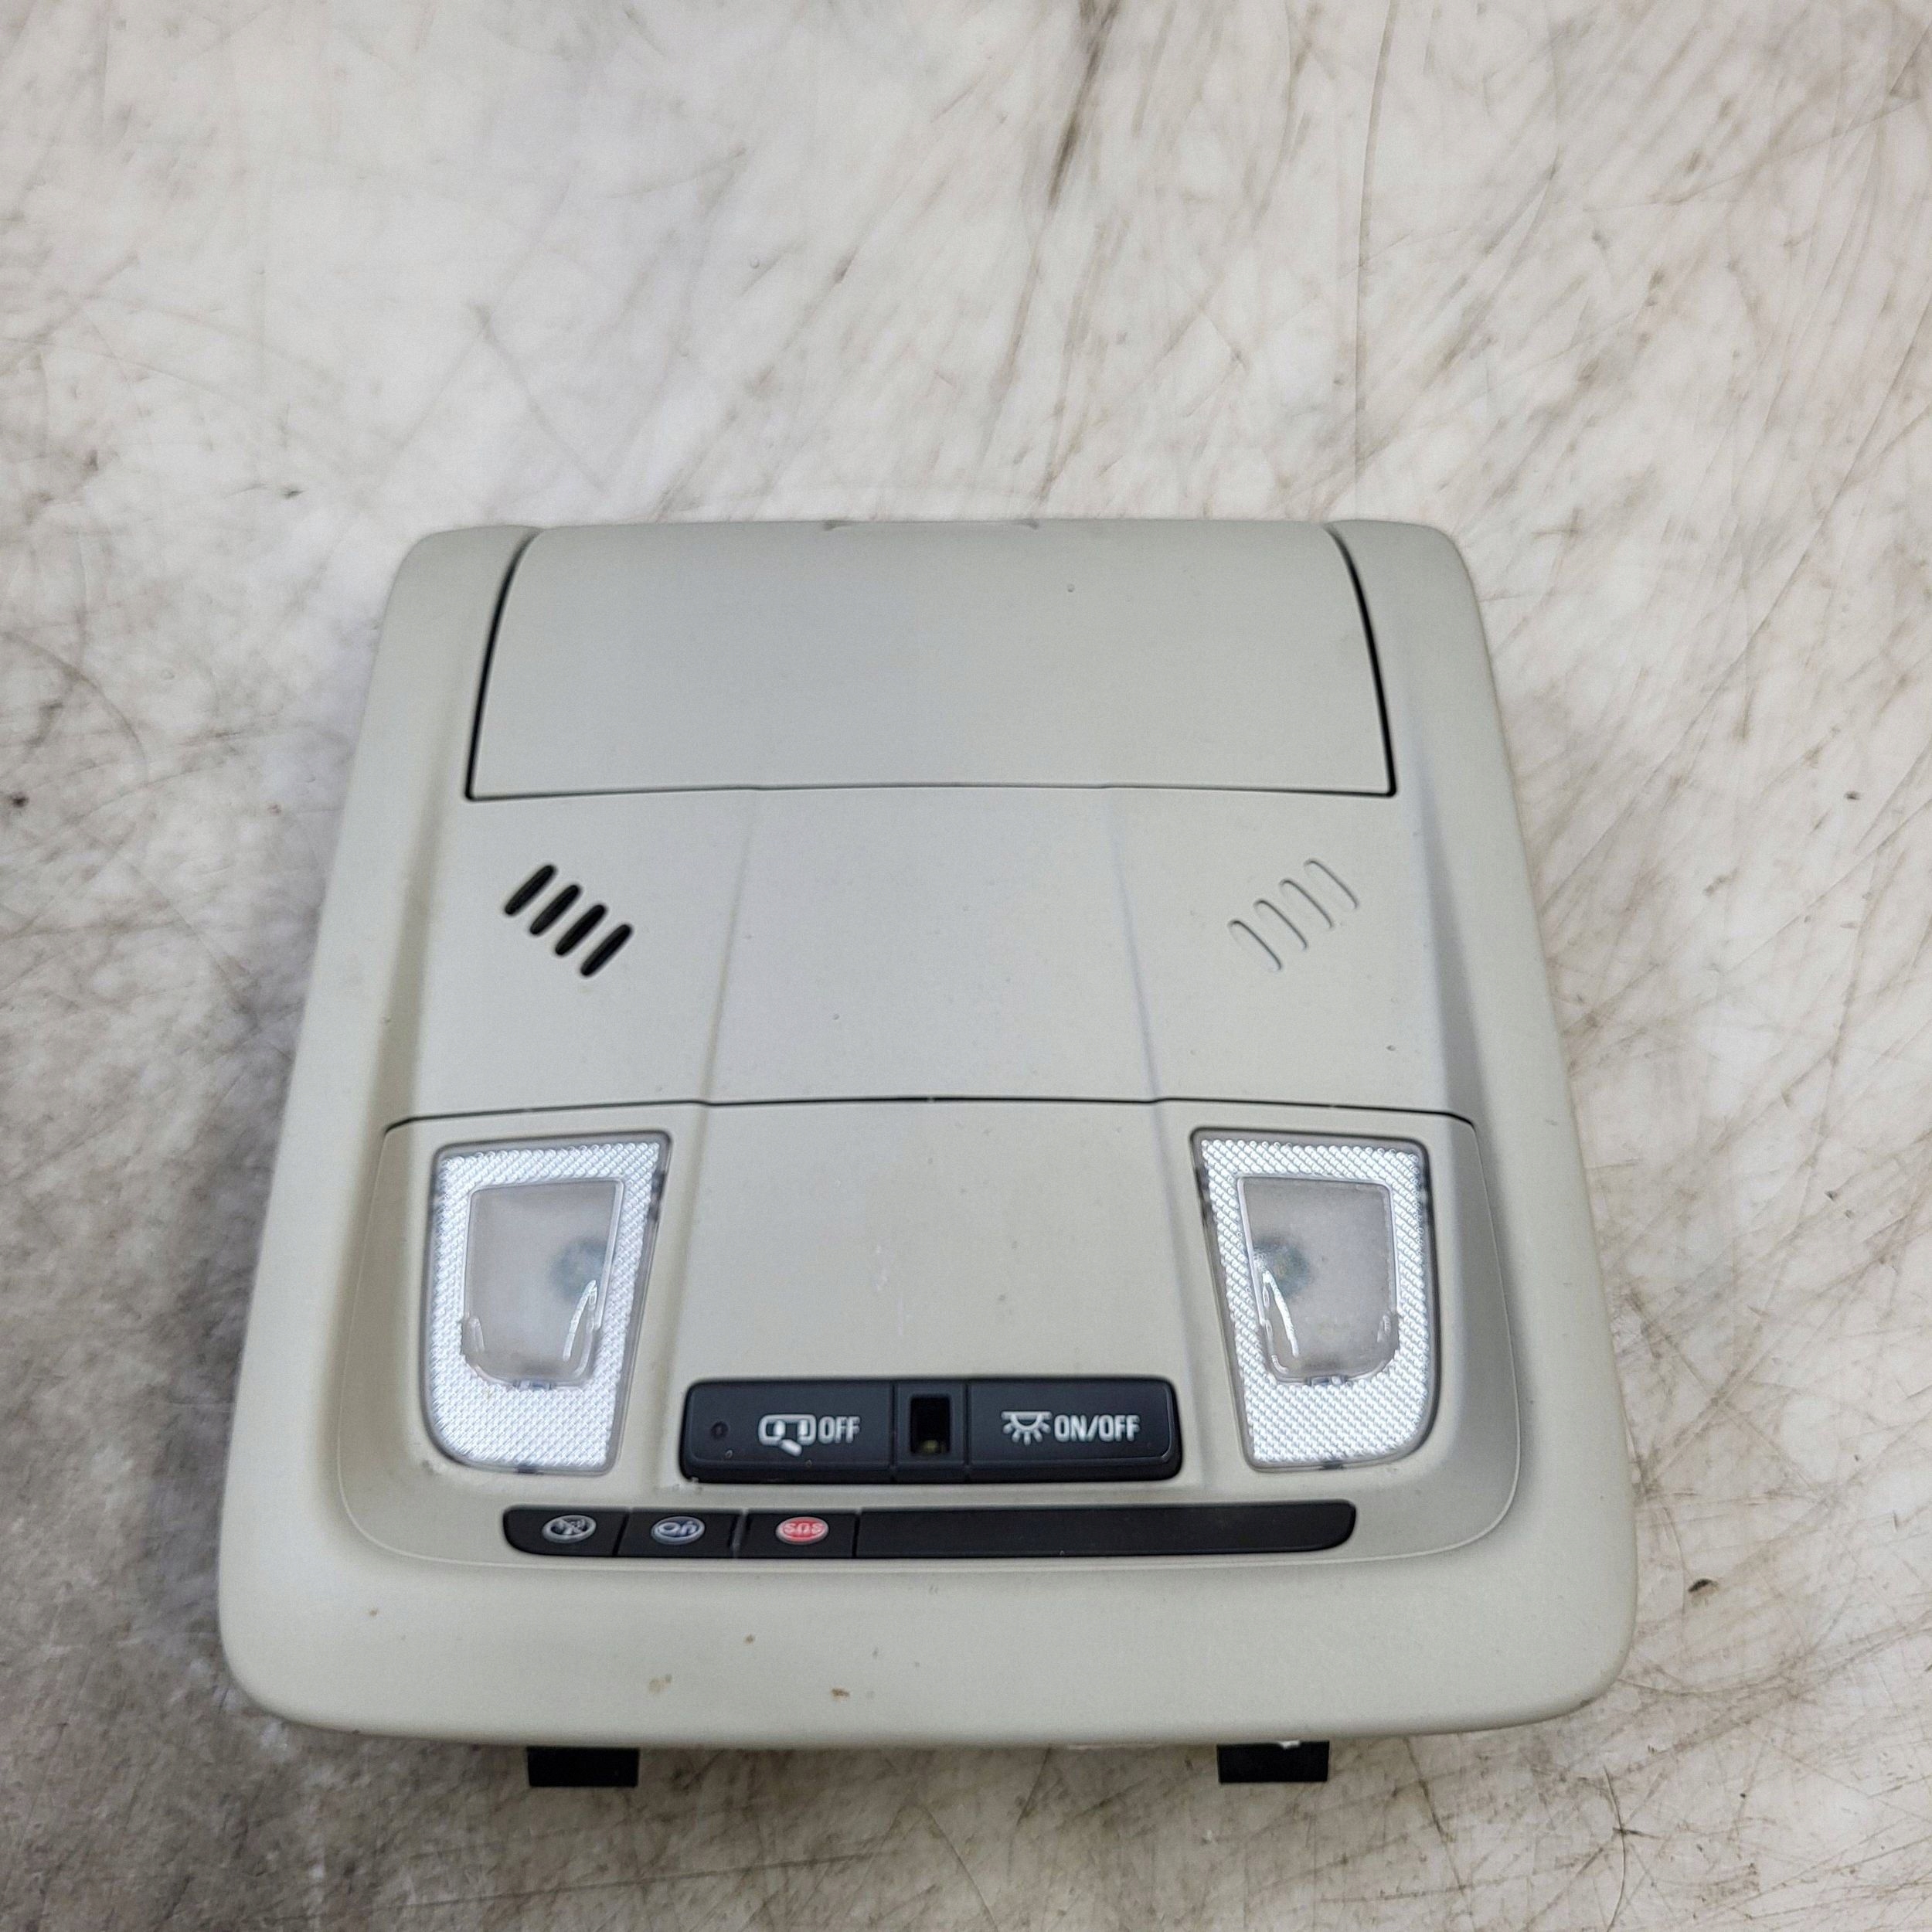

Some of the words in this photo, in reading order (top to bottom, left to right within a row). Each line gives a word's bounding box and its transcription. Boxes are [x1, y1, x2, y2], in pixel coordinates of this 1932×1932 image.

[818, 1416, 860, 1444] OFF
[1054, 1414, 1140, 1442] ON/OFF
[783, 1522, 824, 1535] SOS
